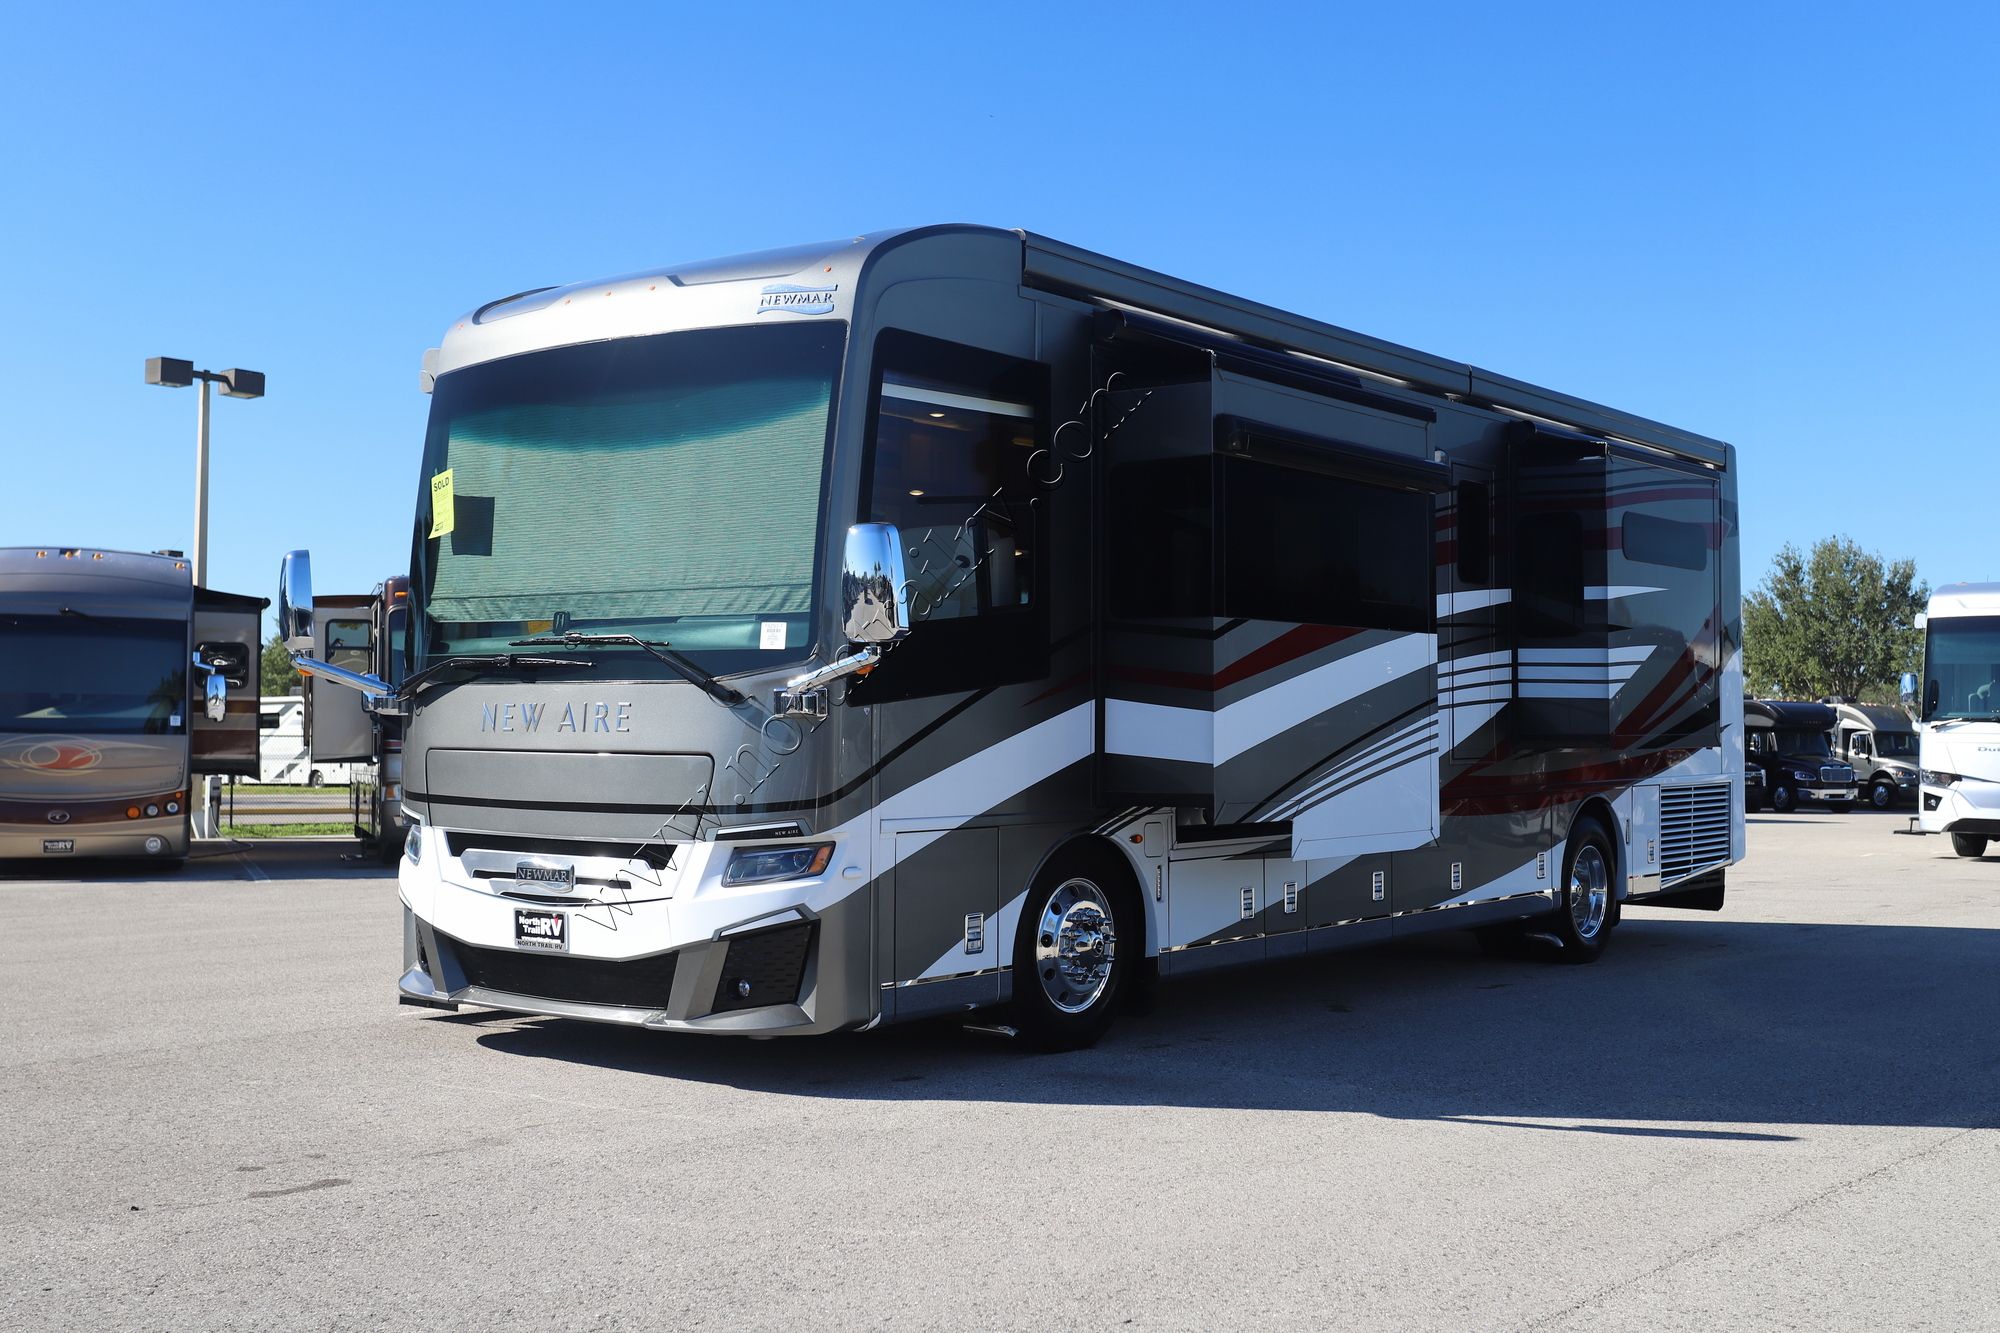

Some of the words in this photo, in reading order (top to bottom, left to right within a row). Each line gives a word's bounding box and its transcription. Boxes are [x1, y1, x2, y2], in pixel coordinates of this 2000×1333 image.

[760, 293, 834, 306] NEWMAR
[433, 477, 450, 492] SOLD
[481, 701, 546, 733] NEW
[557, 701, 632, 733] AIRE
[517, 868, 569, 882] NEWMAR
[518, 916, 540, 925] North
[540, 918, 562, 936] RV
[523, 925, 540, 934] Trail
